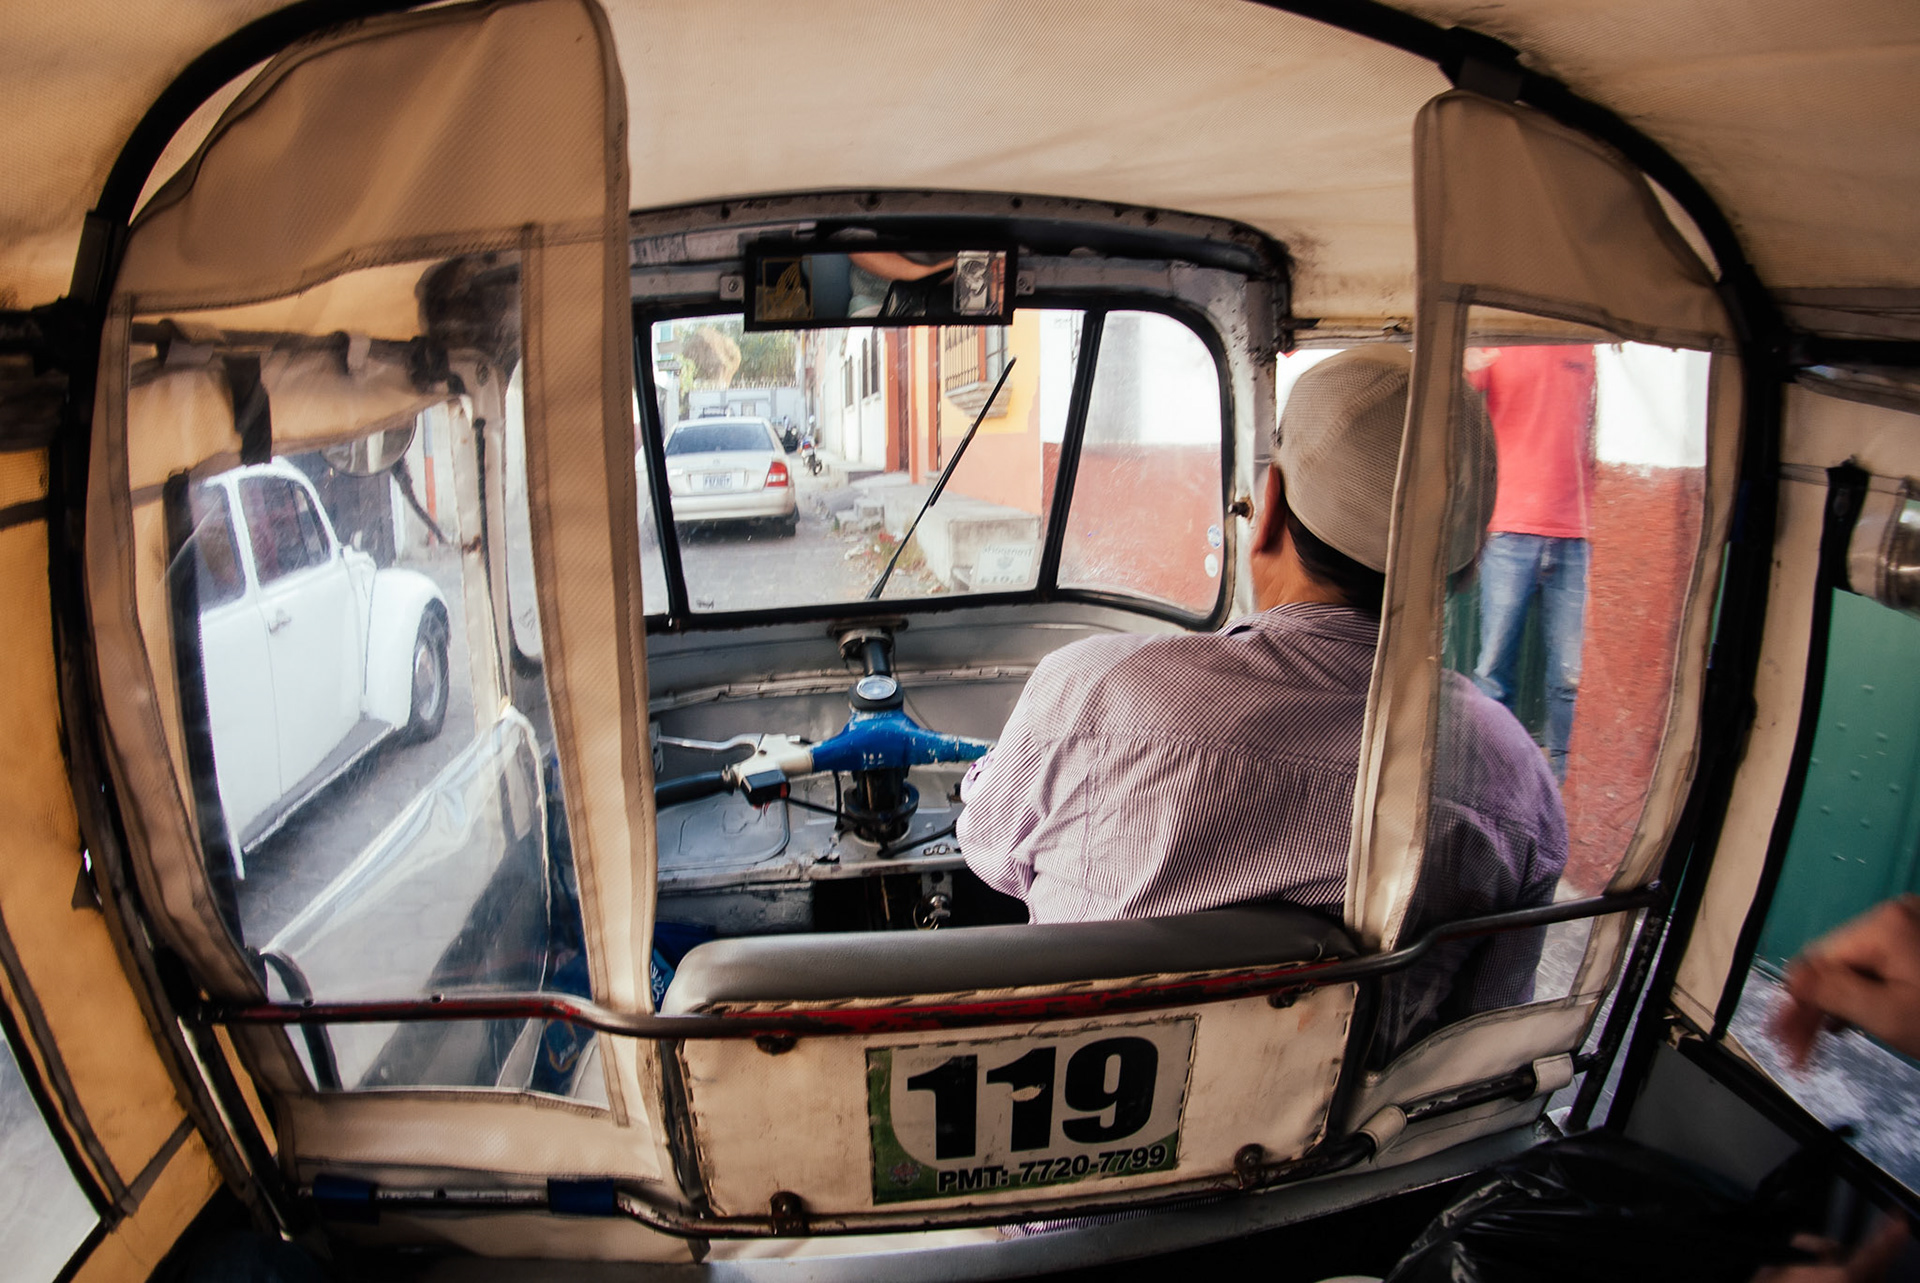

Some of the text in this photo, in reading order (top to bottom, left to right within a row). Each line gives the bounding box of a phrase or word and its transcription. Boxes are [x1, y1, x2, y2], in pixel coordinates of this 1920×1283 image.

[907, 1036, 1158, 1160] 119
[938, 1144, 1168, 1194] PMT: 7720-7799
